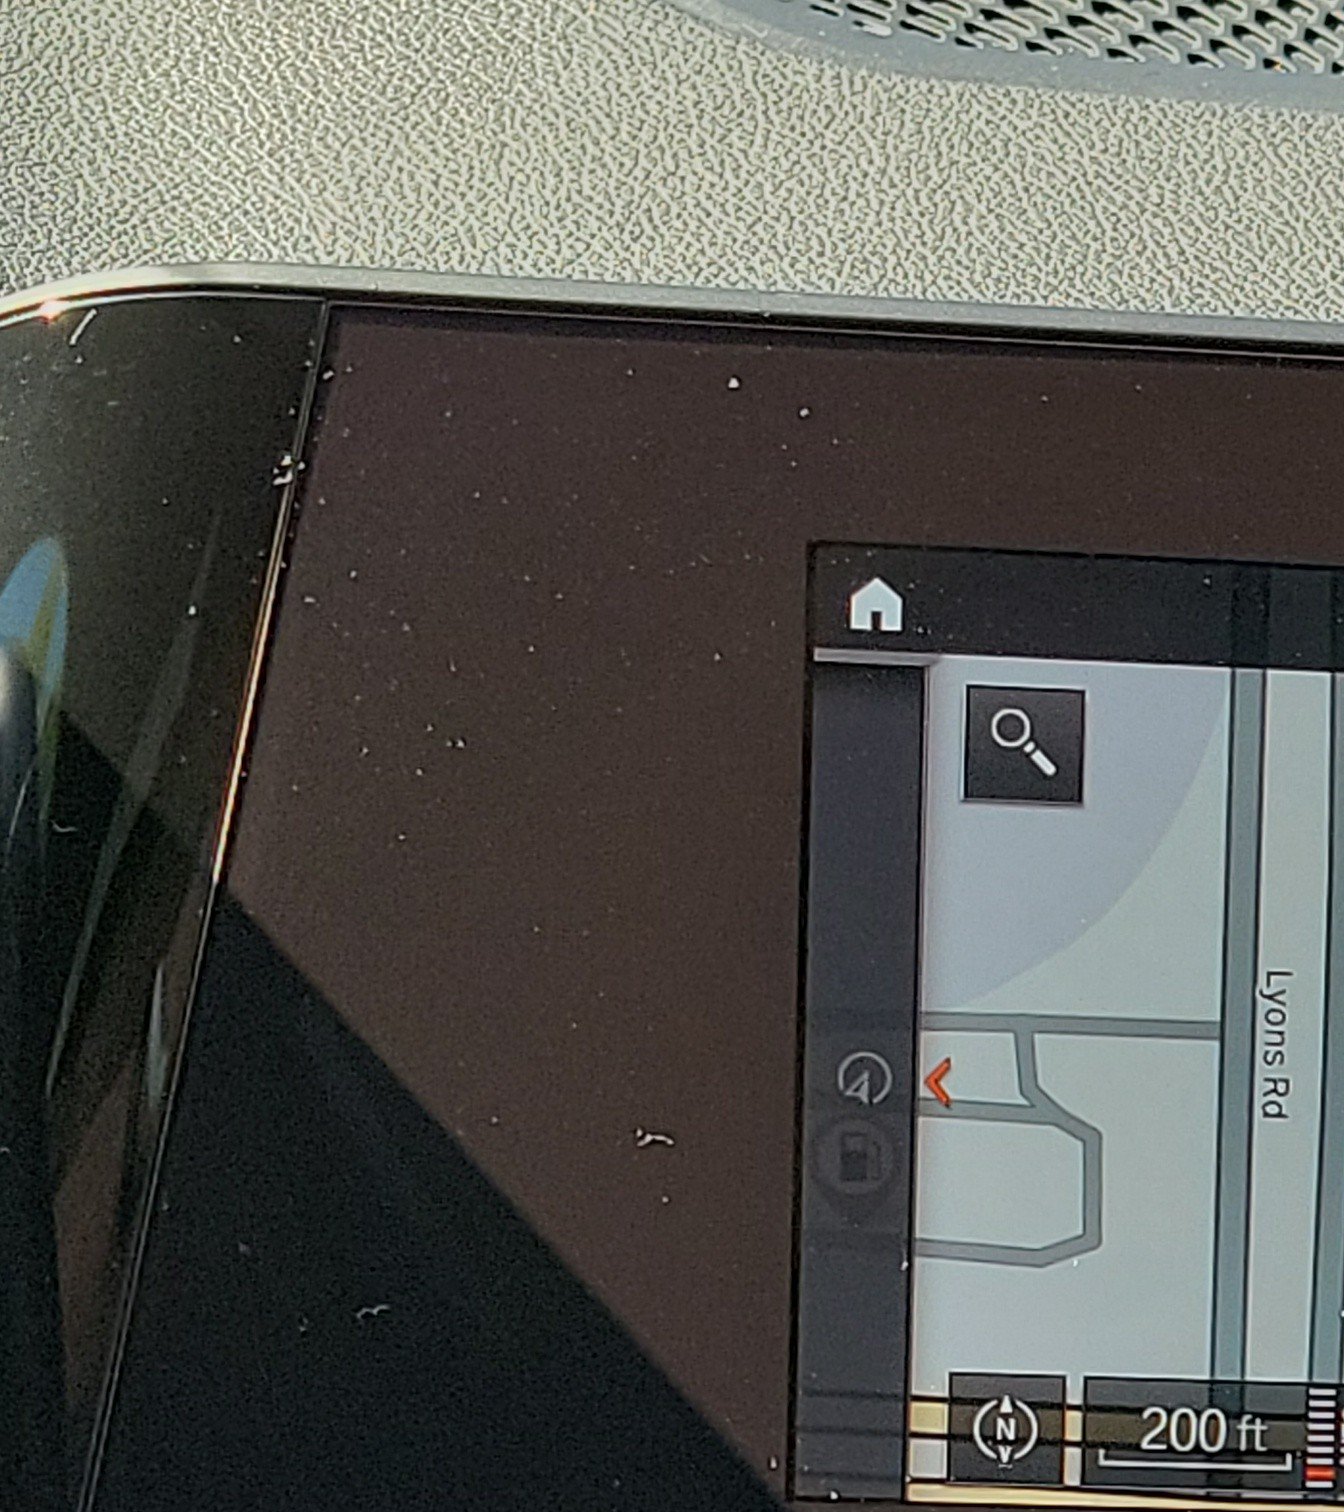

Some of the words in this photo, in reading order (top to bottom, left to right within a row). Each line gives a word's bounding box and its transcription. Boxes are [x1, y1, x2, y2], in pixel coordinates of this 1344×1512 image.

[1259, 970, 1294, 1067] Lyons
[1261, 1077, 1291, 1119] Rd
[996, 1418, 1016, 1441] N
[1140, 1407, 1227, 1452] 200
[1236, 1415, 1268, 1452] ft
